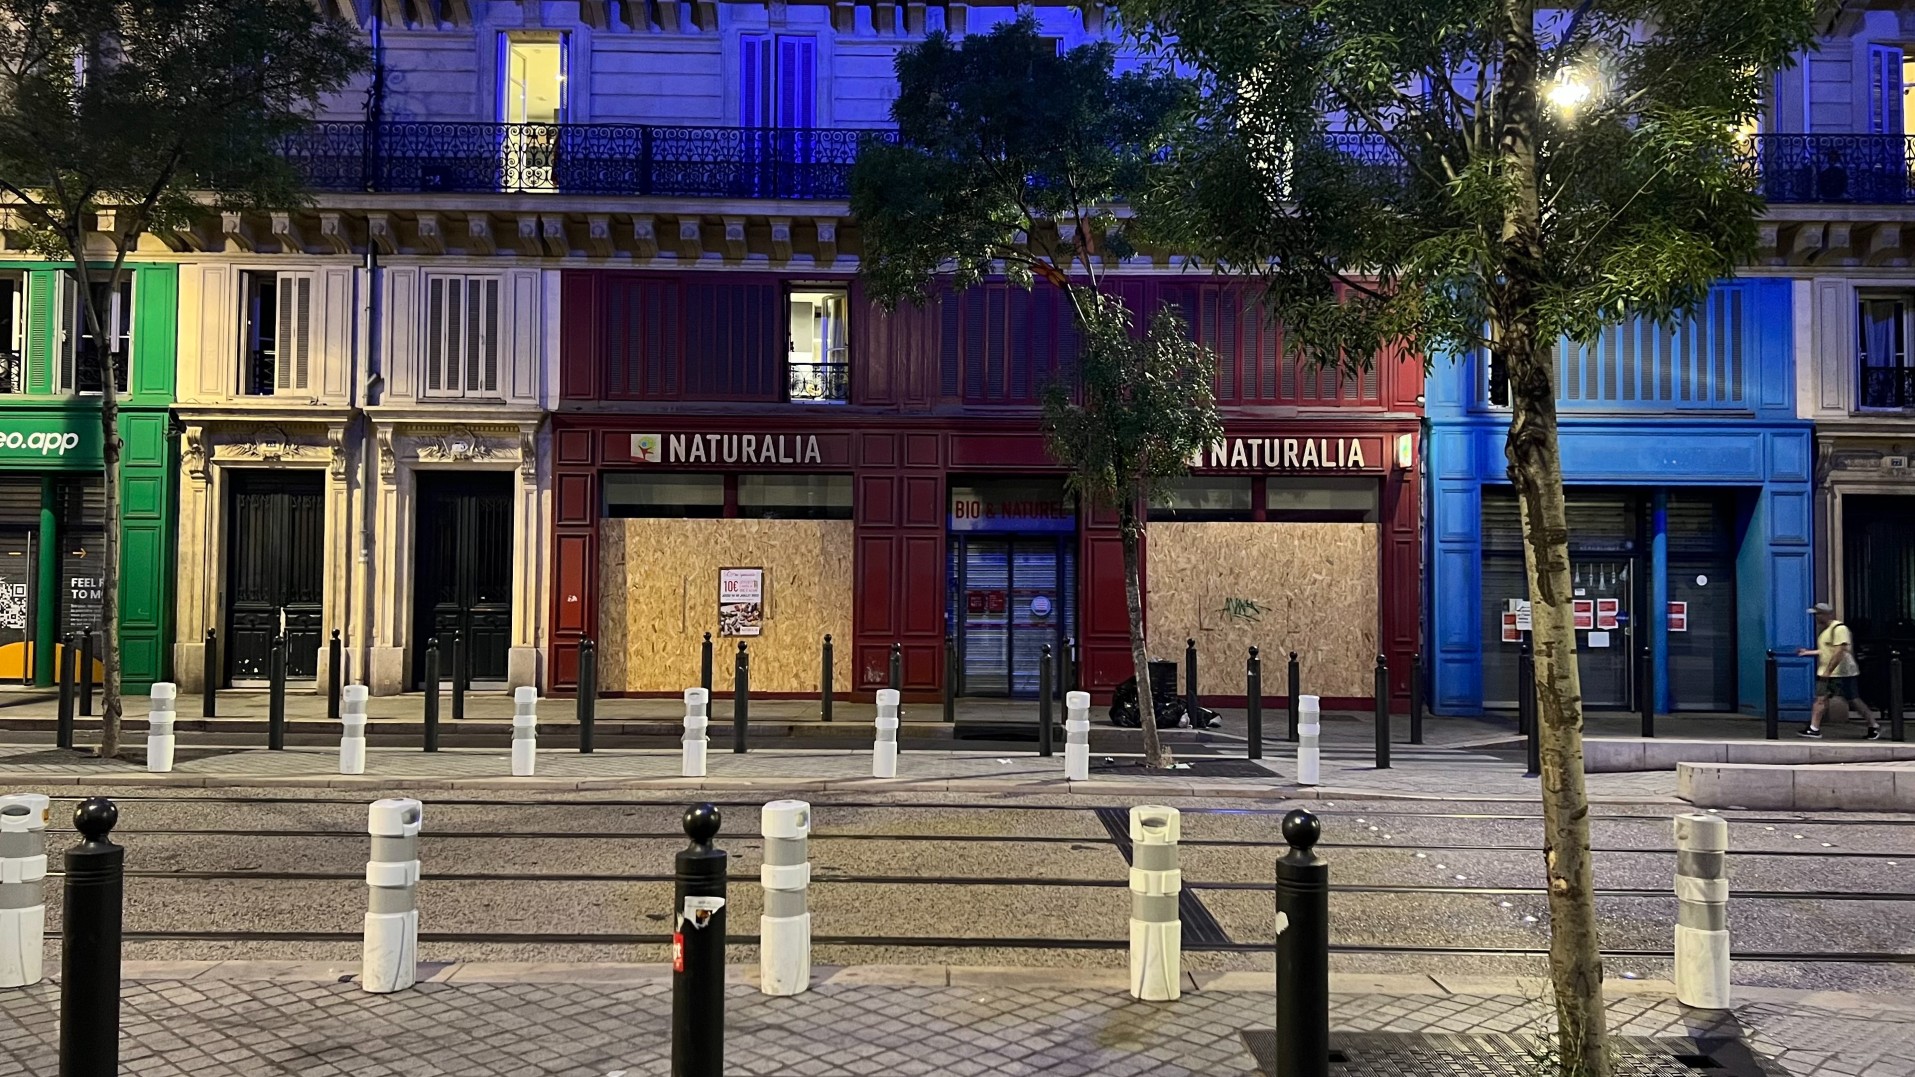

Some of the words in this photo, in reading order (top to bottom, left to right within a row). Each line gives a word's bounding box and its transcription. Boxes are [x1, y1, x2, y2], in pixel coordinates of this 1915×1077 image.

[669, 434, 822, 463] NATURALIA
[1211, 438, 1365, 467] NATURALIA
[955, 501, 980, 519] BIO
[986, 502, 996, 519] &
[1002, 501, 1067, 519] NATUREL
[71, 578, 97, 588] FEEL
[724, 580, 739, 592] 10€
[71, 589, 88, 599] TO
